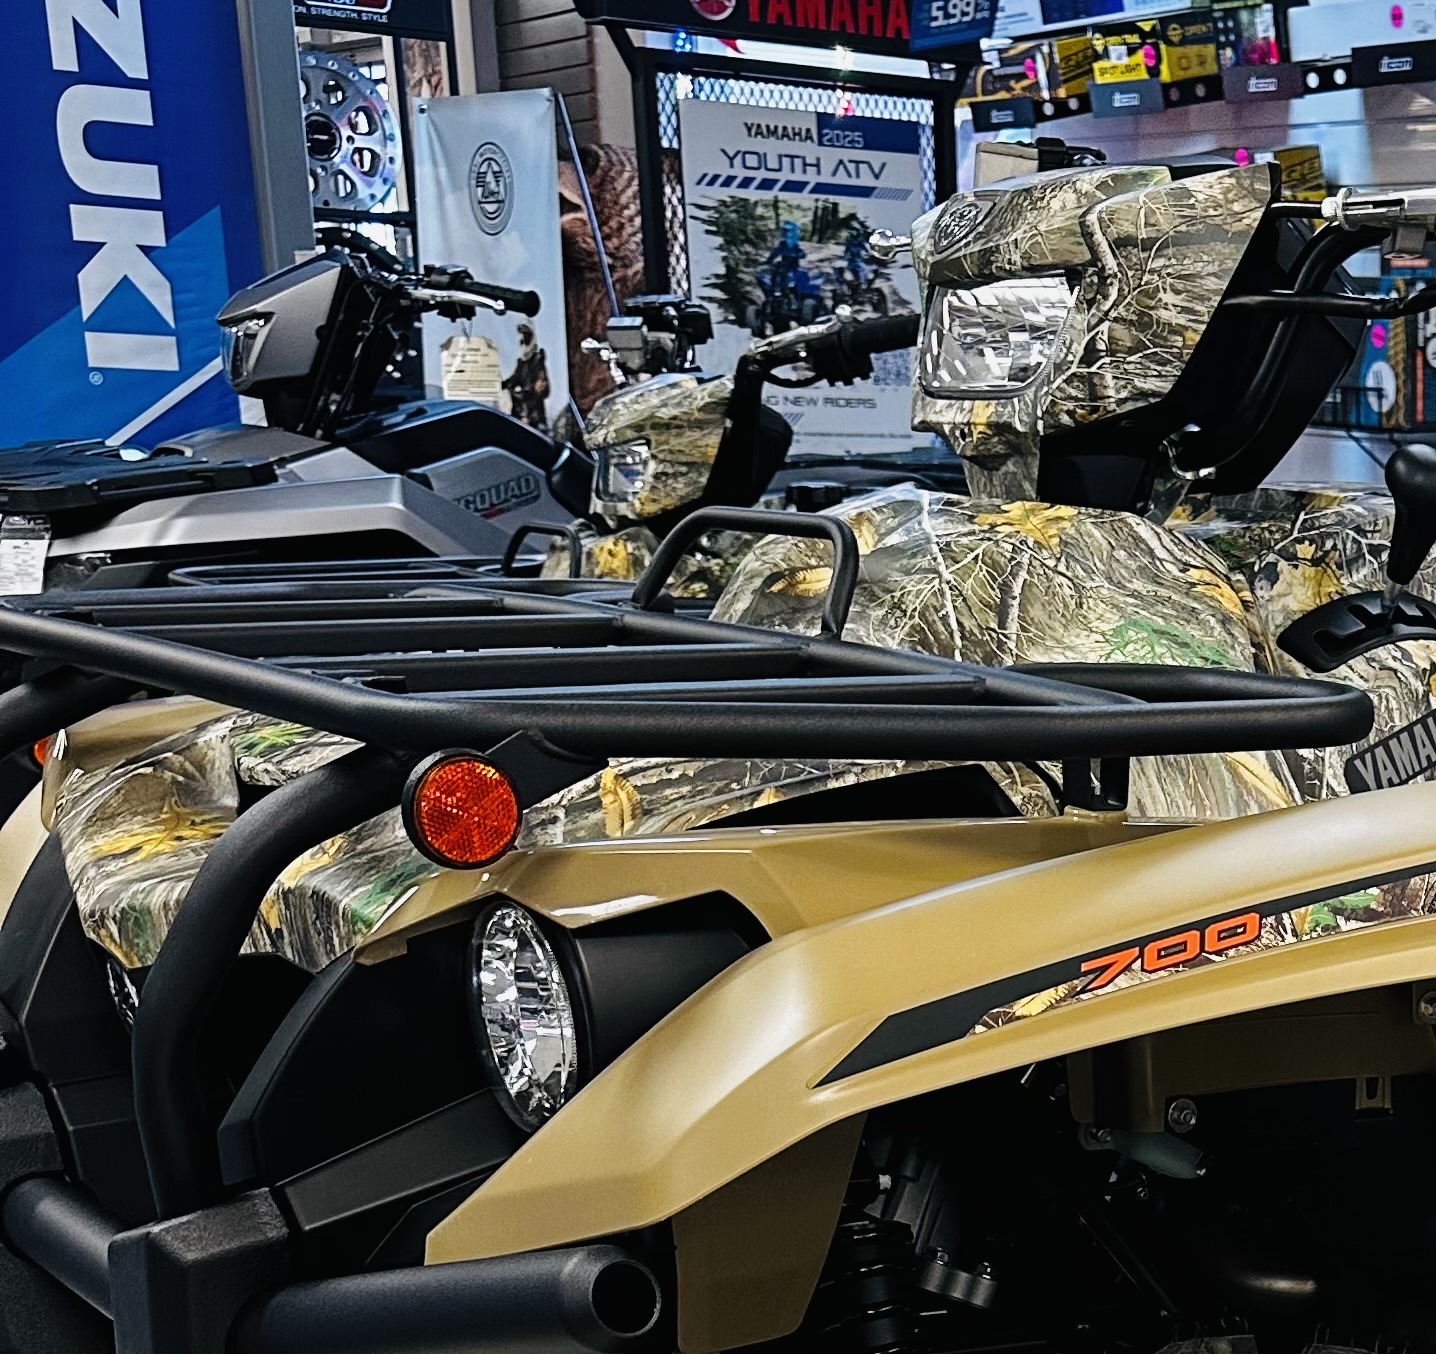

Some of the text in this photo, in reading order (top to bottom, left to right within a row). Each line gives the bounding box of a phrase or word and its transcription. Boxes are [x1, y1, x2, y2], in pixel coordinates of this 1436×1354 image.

[743, 122, 864, 148] YAMAHA 2025
[720, 149, 887, 180] YOUTH ATV
[45, 0, 180, 372] ZUKI
[784, 396, 820, 407] NEW
[823, 397, 878, 409] RIDERS
[1080, 912, 1260, 990] 700
